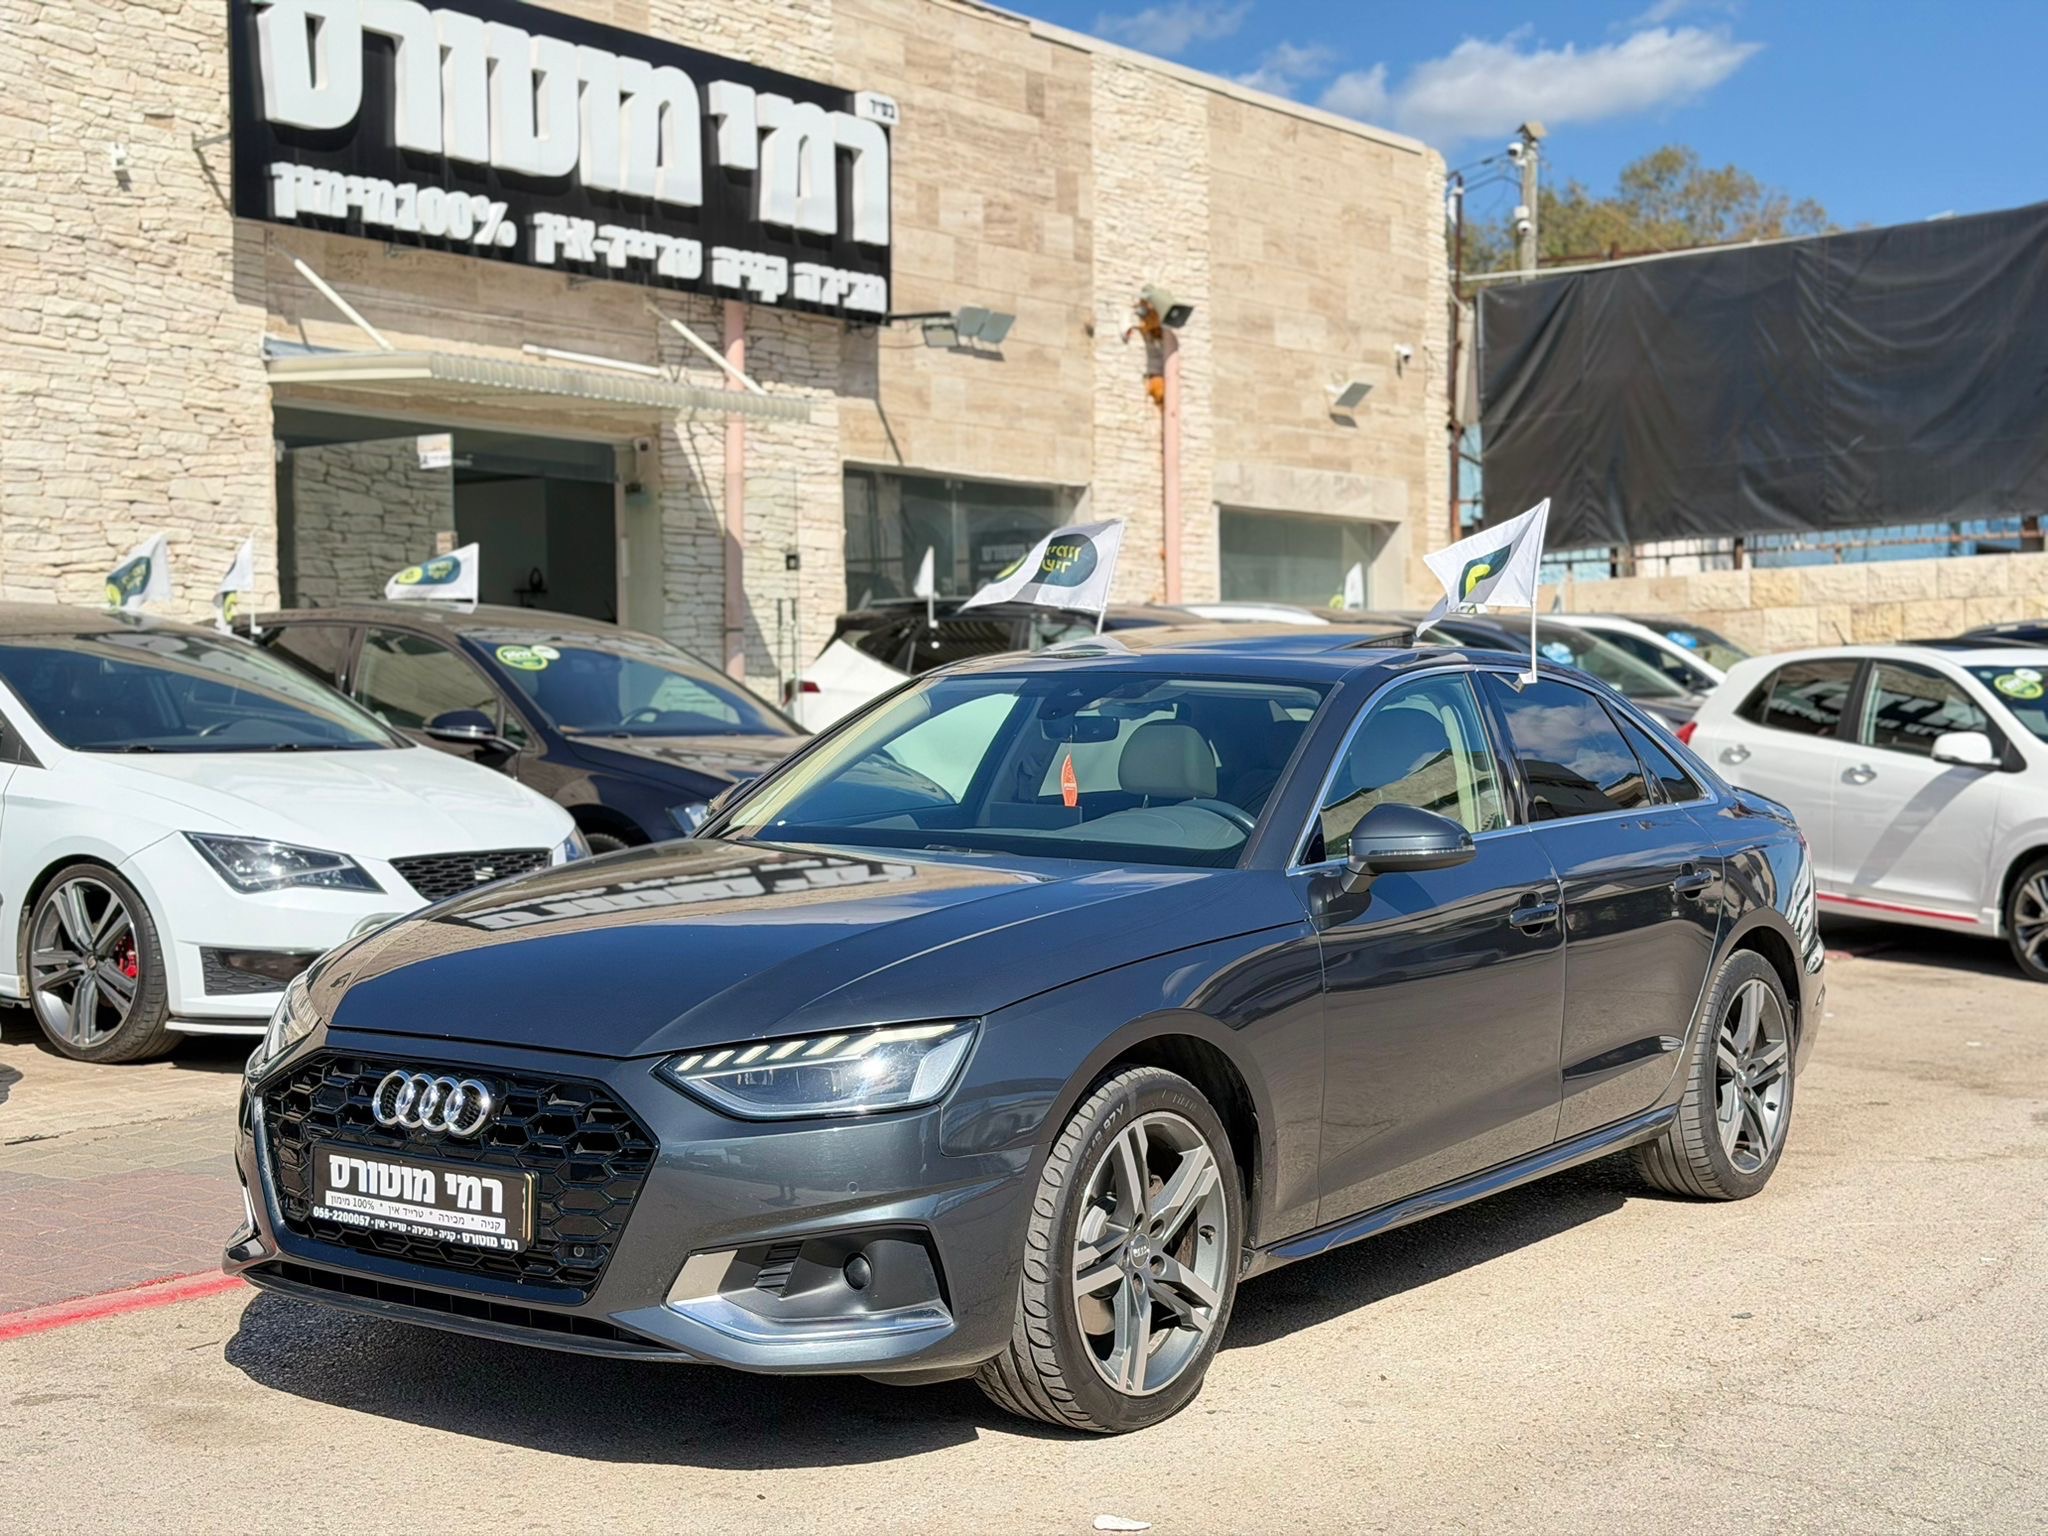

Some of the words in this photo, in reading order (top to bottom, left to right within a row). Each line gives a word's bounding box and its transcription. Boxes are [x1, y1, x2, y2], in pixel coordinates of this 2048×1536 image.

[256, 0, 704, 207] מוטורס
[708, 79, 890, 246] רמי
[793, 261, 888, 314] מכירה
[329, 1154, 436, 1204] מוטורס
[444, 1171, 503, 1214] רמי
[352, 1197, 375, 1211] 100%
[388, 1204, 400, 1215] אין
[312, 1206, 371, 1227] 055-2200057
[402, 1207, 424, 1218] טרייד
[438, 1212, 465, 1225] מכירה
[411, 1224, 434, 1237] מכירה
[480, 1218, 501, 1231] קניה
[461, 1231, 498, 1248] מוטורס
[500, 1238, 519, 1251] רמי
